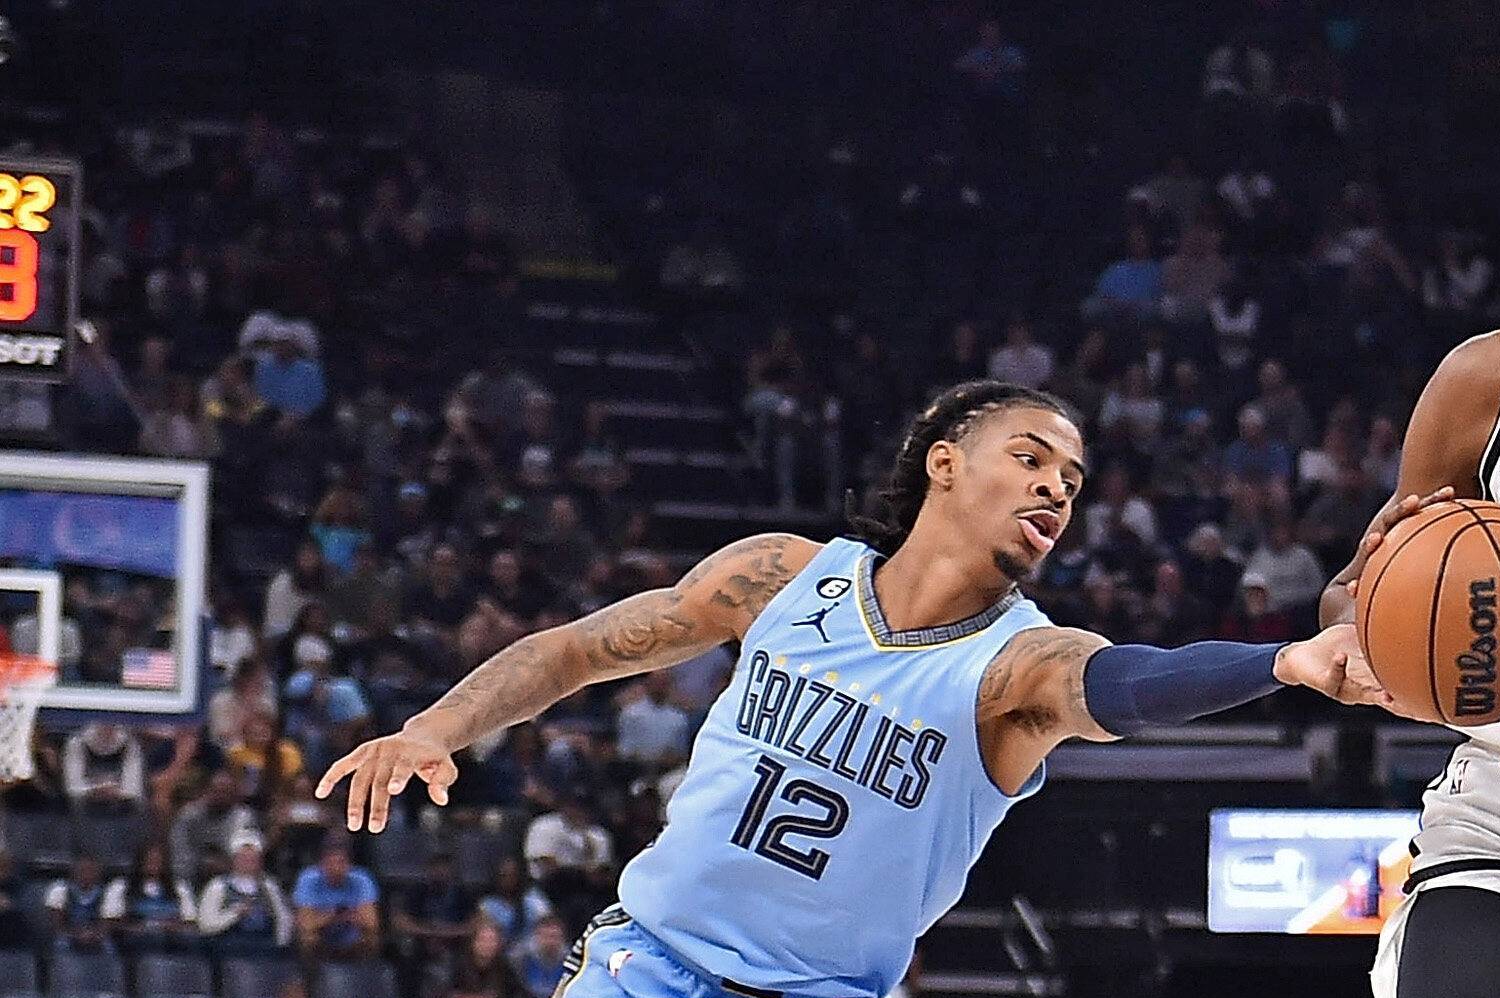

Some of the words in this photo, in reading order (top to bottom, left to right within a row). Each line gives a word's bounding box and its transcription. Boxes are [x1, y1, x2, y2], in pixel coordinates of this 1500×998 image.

[819, 579, 850, 598] 6
[1455, 576, 1497, 717] Wilson
[736, 649, 948, 811] GRIZZLIES
[730, 755, 850, 881] 12
